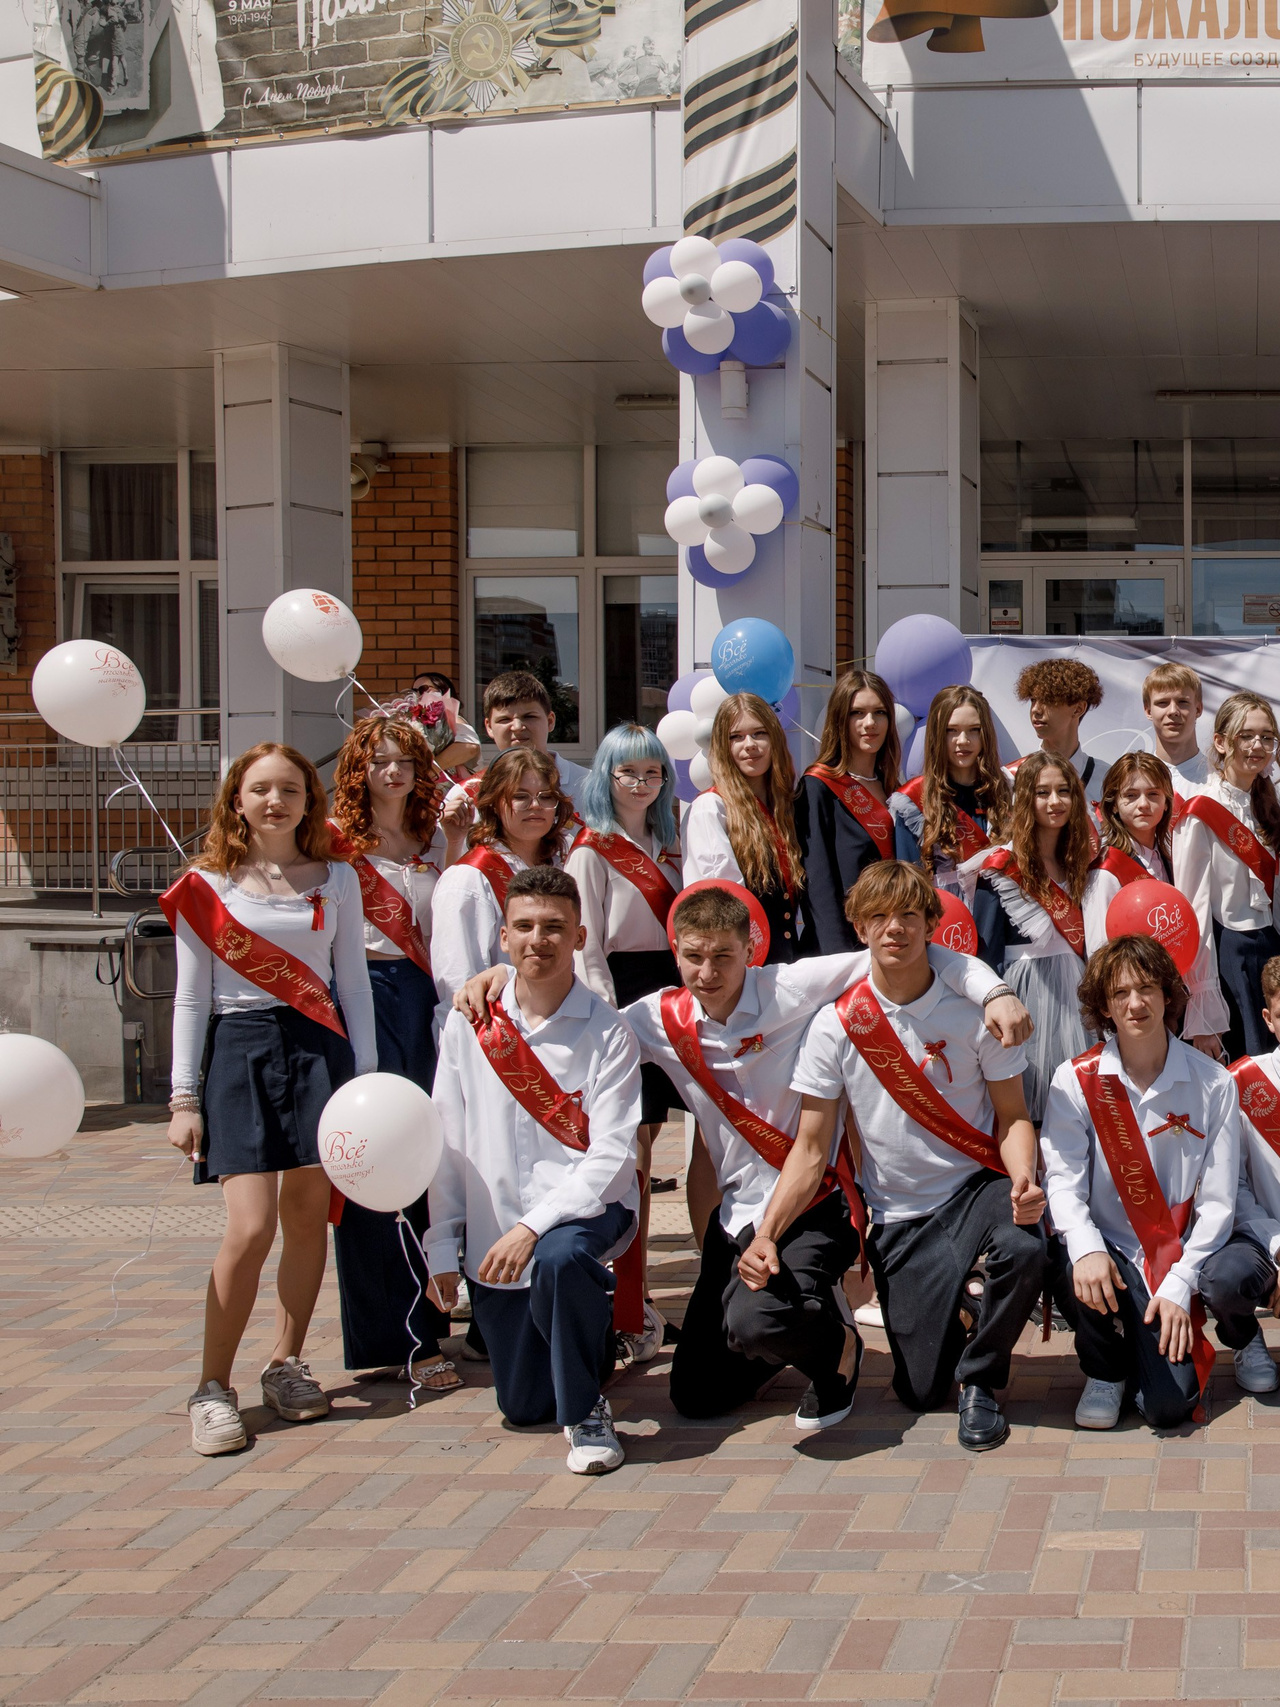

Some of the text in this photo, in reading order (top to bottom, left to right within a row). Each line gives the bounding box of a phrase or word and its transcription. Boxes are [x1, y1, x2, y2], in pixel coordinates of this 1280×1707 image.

[228, 2, 237, 11] 9
[1134, 53, 1224, 69] БУДУЩЕЕ
[243, 87, 252, 109] С
[297, 75, 346, 105] Победы!
[718, 637, 747, 670] Всё
[1147, 903, 1182, 938] Всё
[324, 1131, 368, 1162] Всё
[1120, 1160, 1155, 1206] 2025
